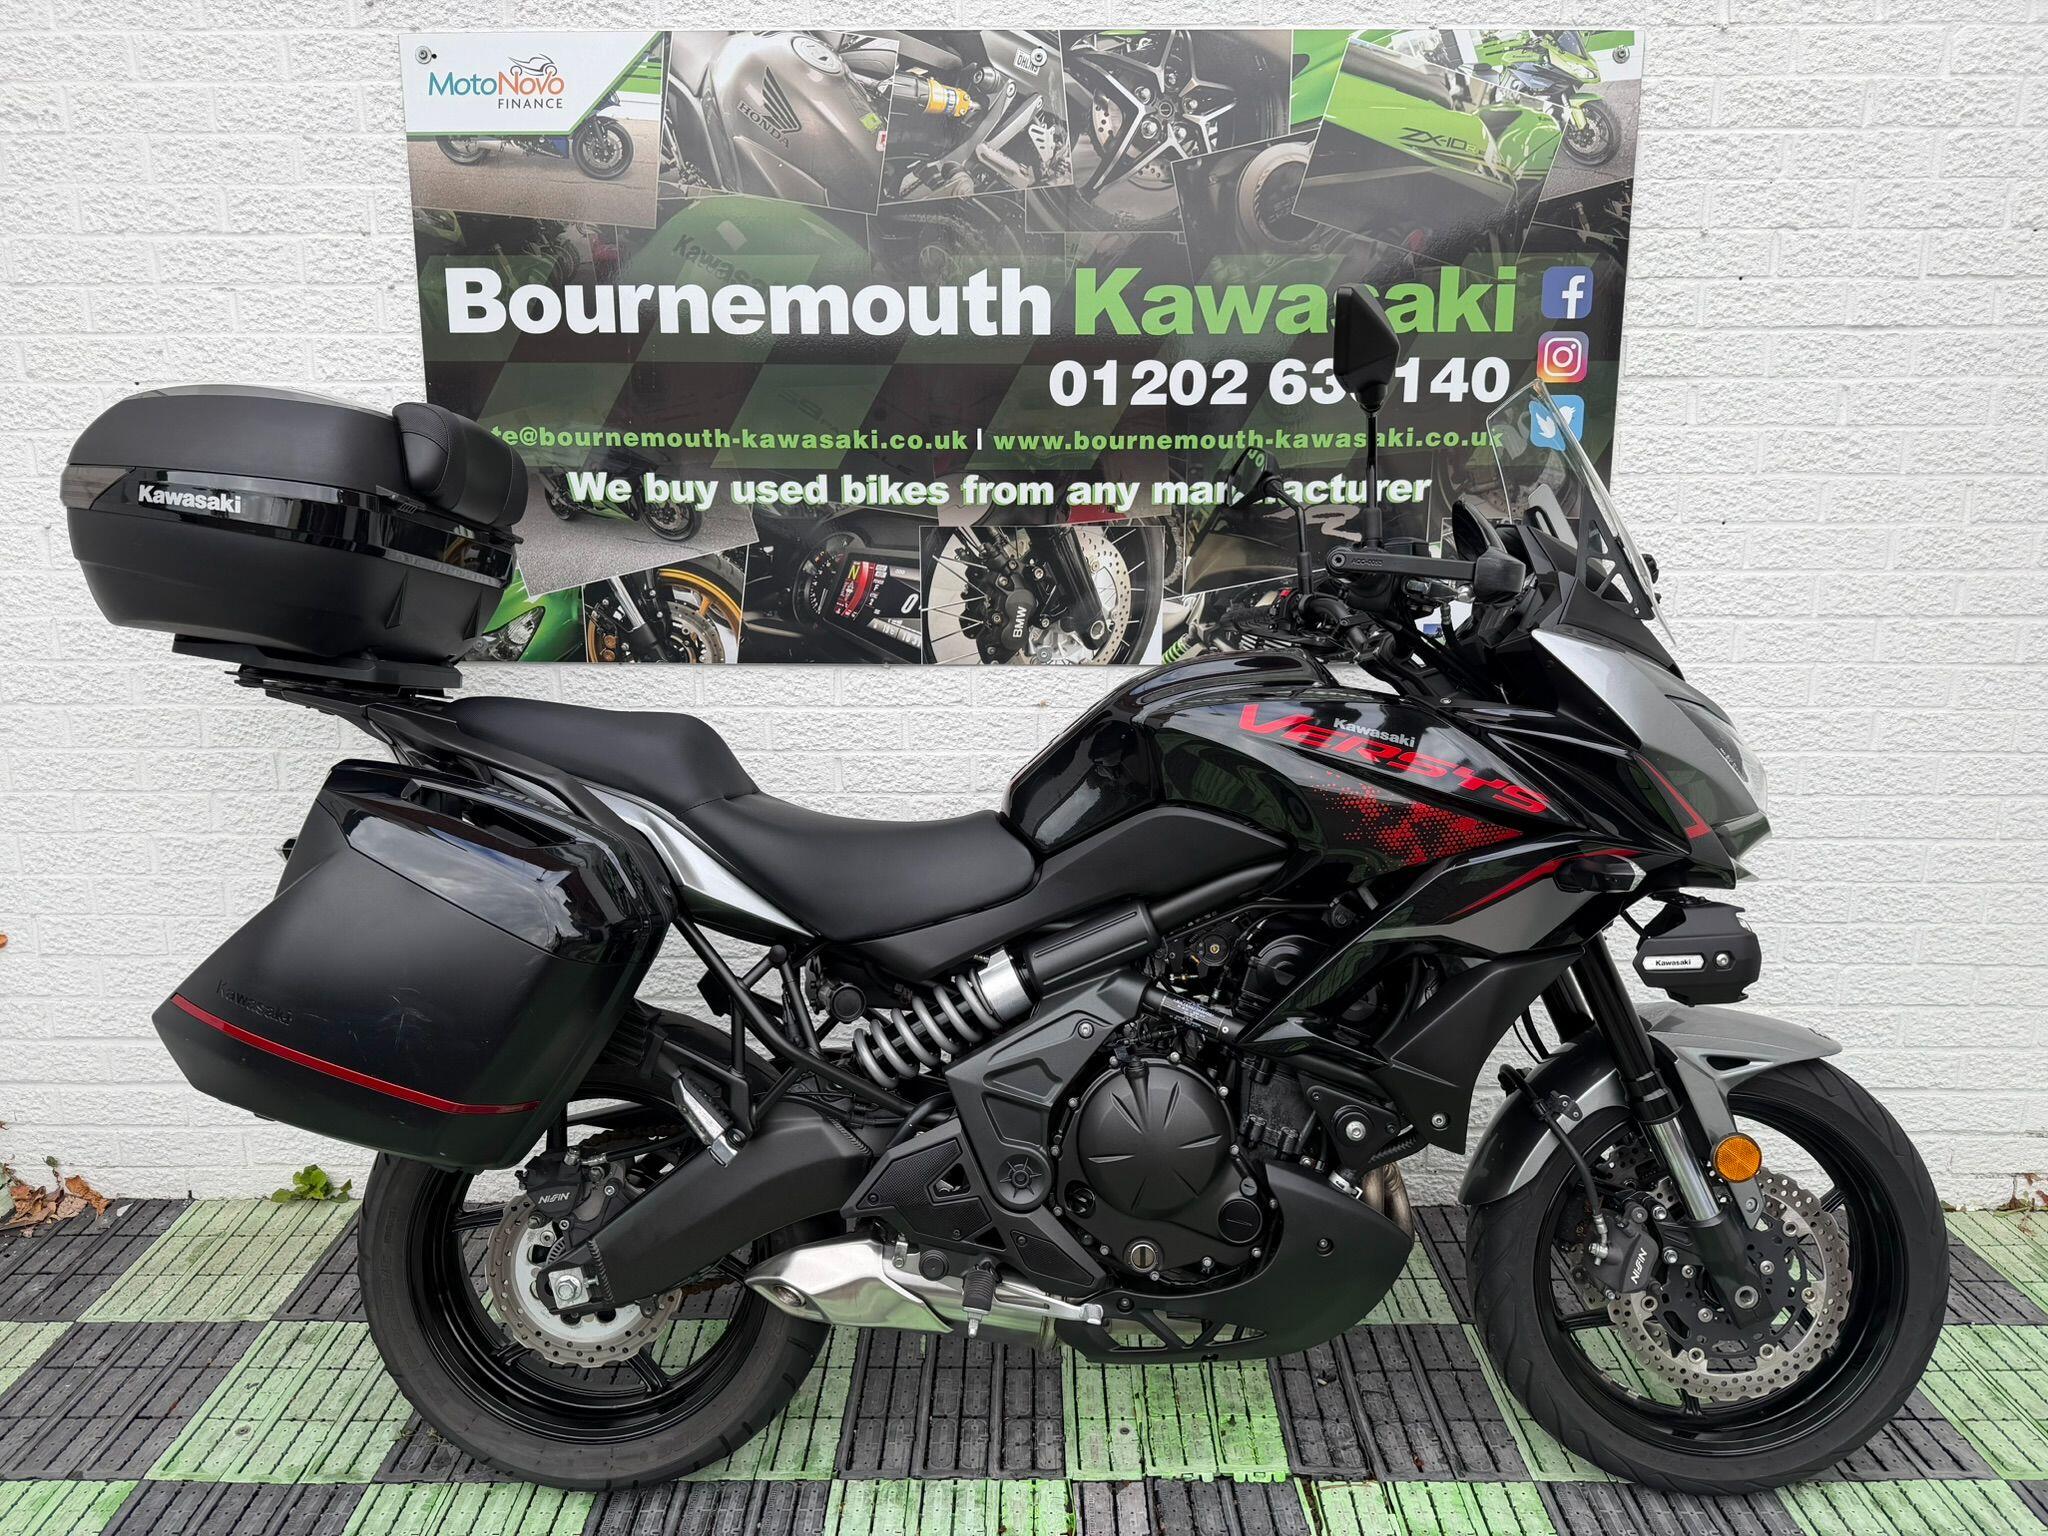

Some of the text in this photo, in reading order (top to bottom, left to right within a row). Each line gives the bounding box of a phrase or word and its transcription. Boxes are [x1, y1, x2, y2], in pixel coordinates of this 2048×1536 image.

[428, 71, 565, 96] MotoNovo
[498, 98, 563, 109] FINANCE
[738, 102, 789, 149] HONDA
[444, 266, 1516, 336] Bournemouth Kawaaki
[1049, 356, 1510, 406] 01202 63140
[138, 484, 242, 514] Kawasaki
[566, 472, 632, 503] We
[644, 472, 719, 511] buy
[730, 474, 828, 505] used
[841, 474, 950, 506] bikes
[960, 474, 1054, 506] from
[1067, 481, 1141, 512] any
[1012, 606, 1027, 638] BMW
[1333, 717, 1416, 748] Kawasaki
[1238, 703, 1551, 814] VERSYS
[1655, 959, 1692, 967] Kawasaki
[1630, 1247, 1648, 1285] NISSIN
